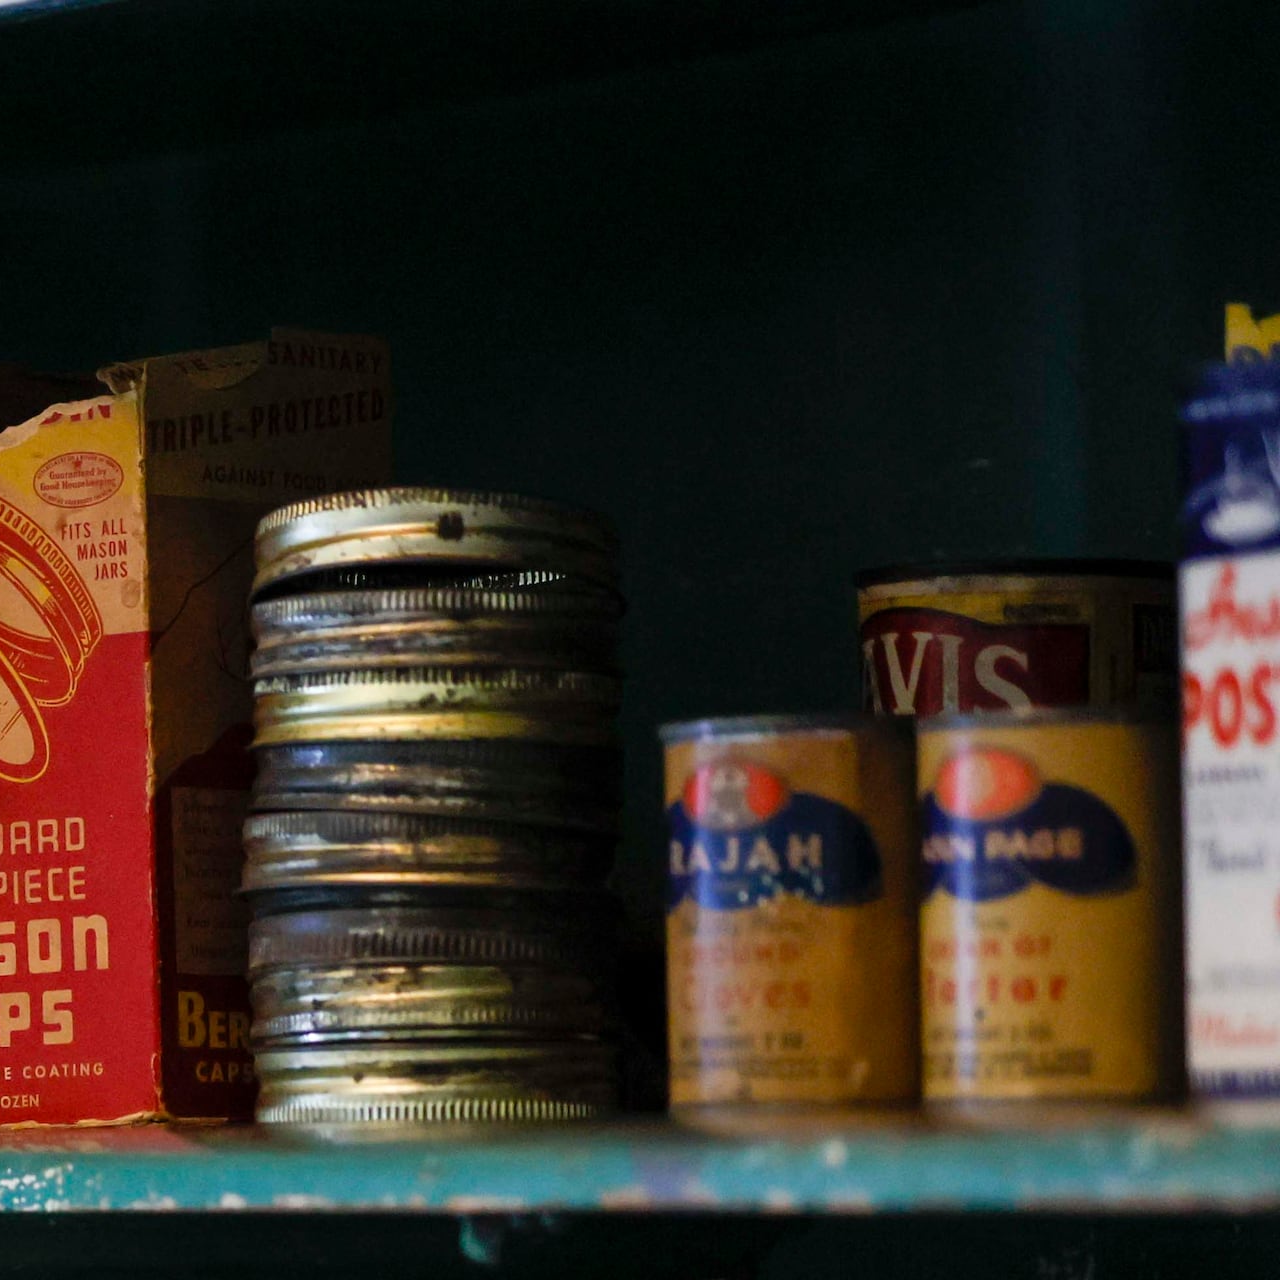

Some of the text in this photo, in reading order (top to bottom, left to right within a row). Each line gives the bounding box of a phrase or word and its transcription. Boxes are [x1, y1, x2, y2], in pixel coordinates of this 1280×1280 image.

[267, 340, 383, 375] SANITARY
[148, 388, 385, 453] TRIPLE-PROTECTED
[202, 465, 274, 486] AGAINST
[60, 517, 128, 542] FITS ALL
[77, 540, 128, 561] MASON
[94, 561, 129, 581] JARS
[22, 1062, 105, 1080] COATING
